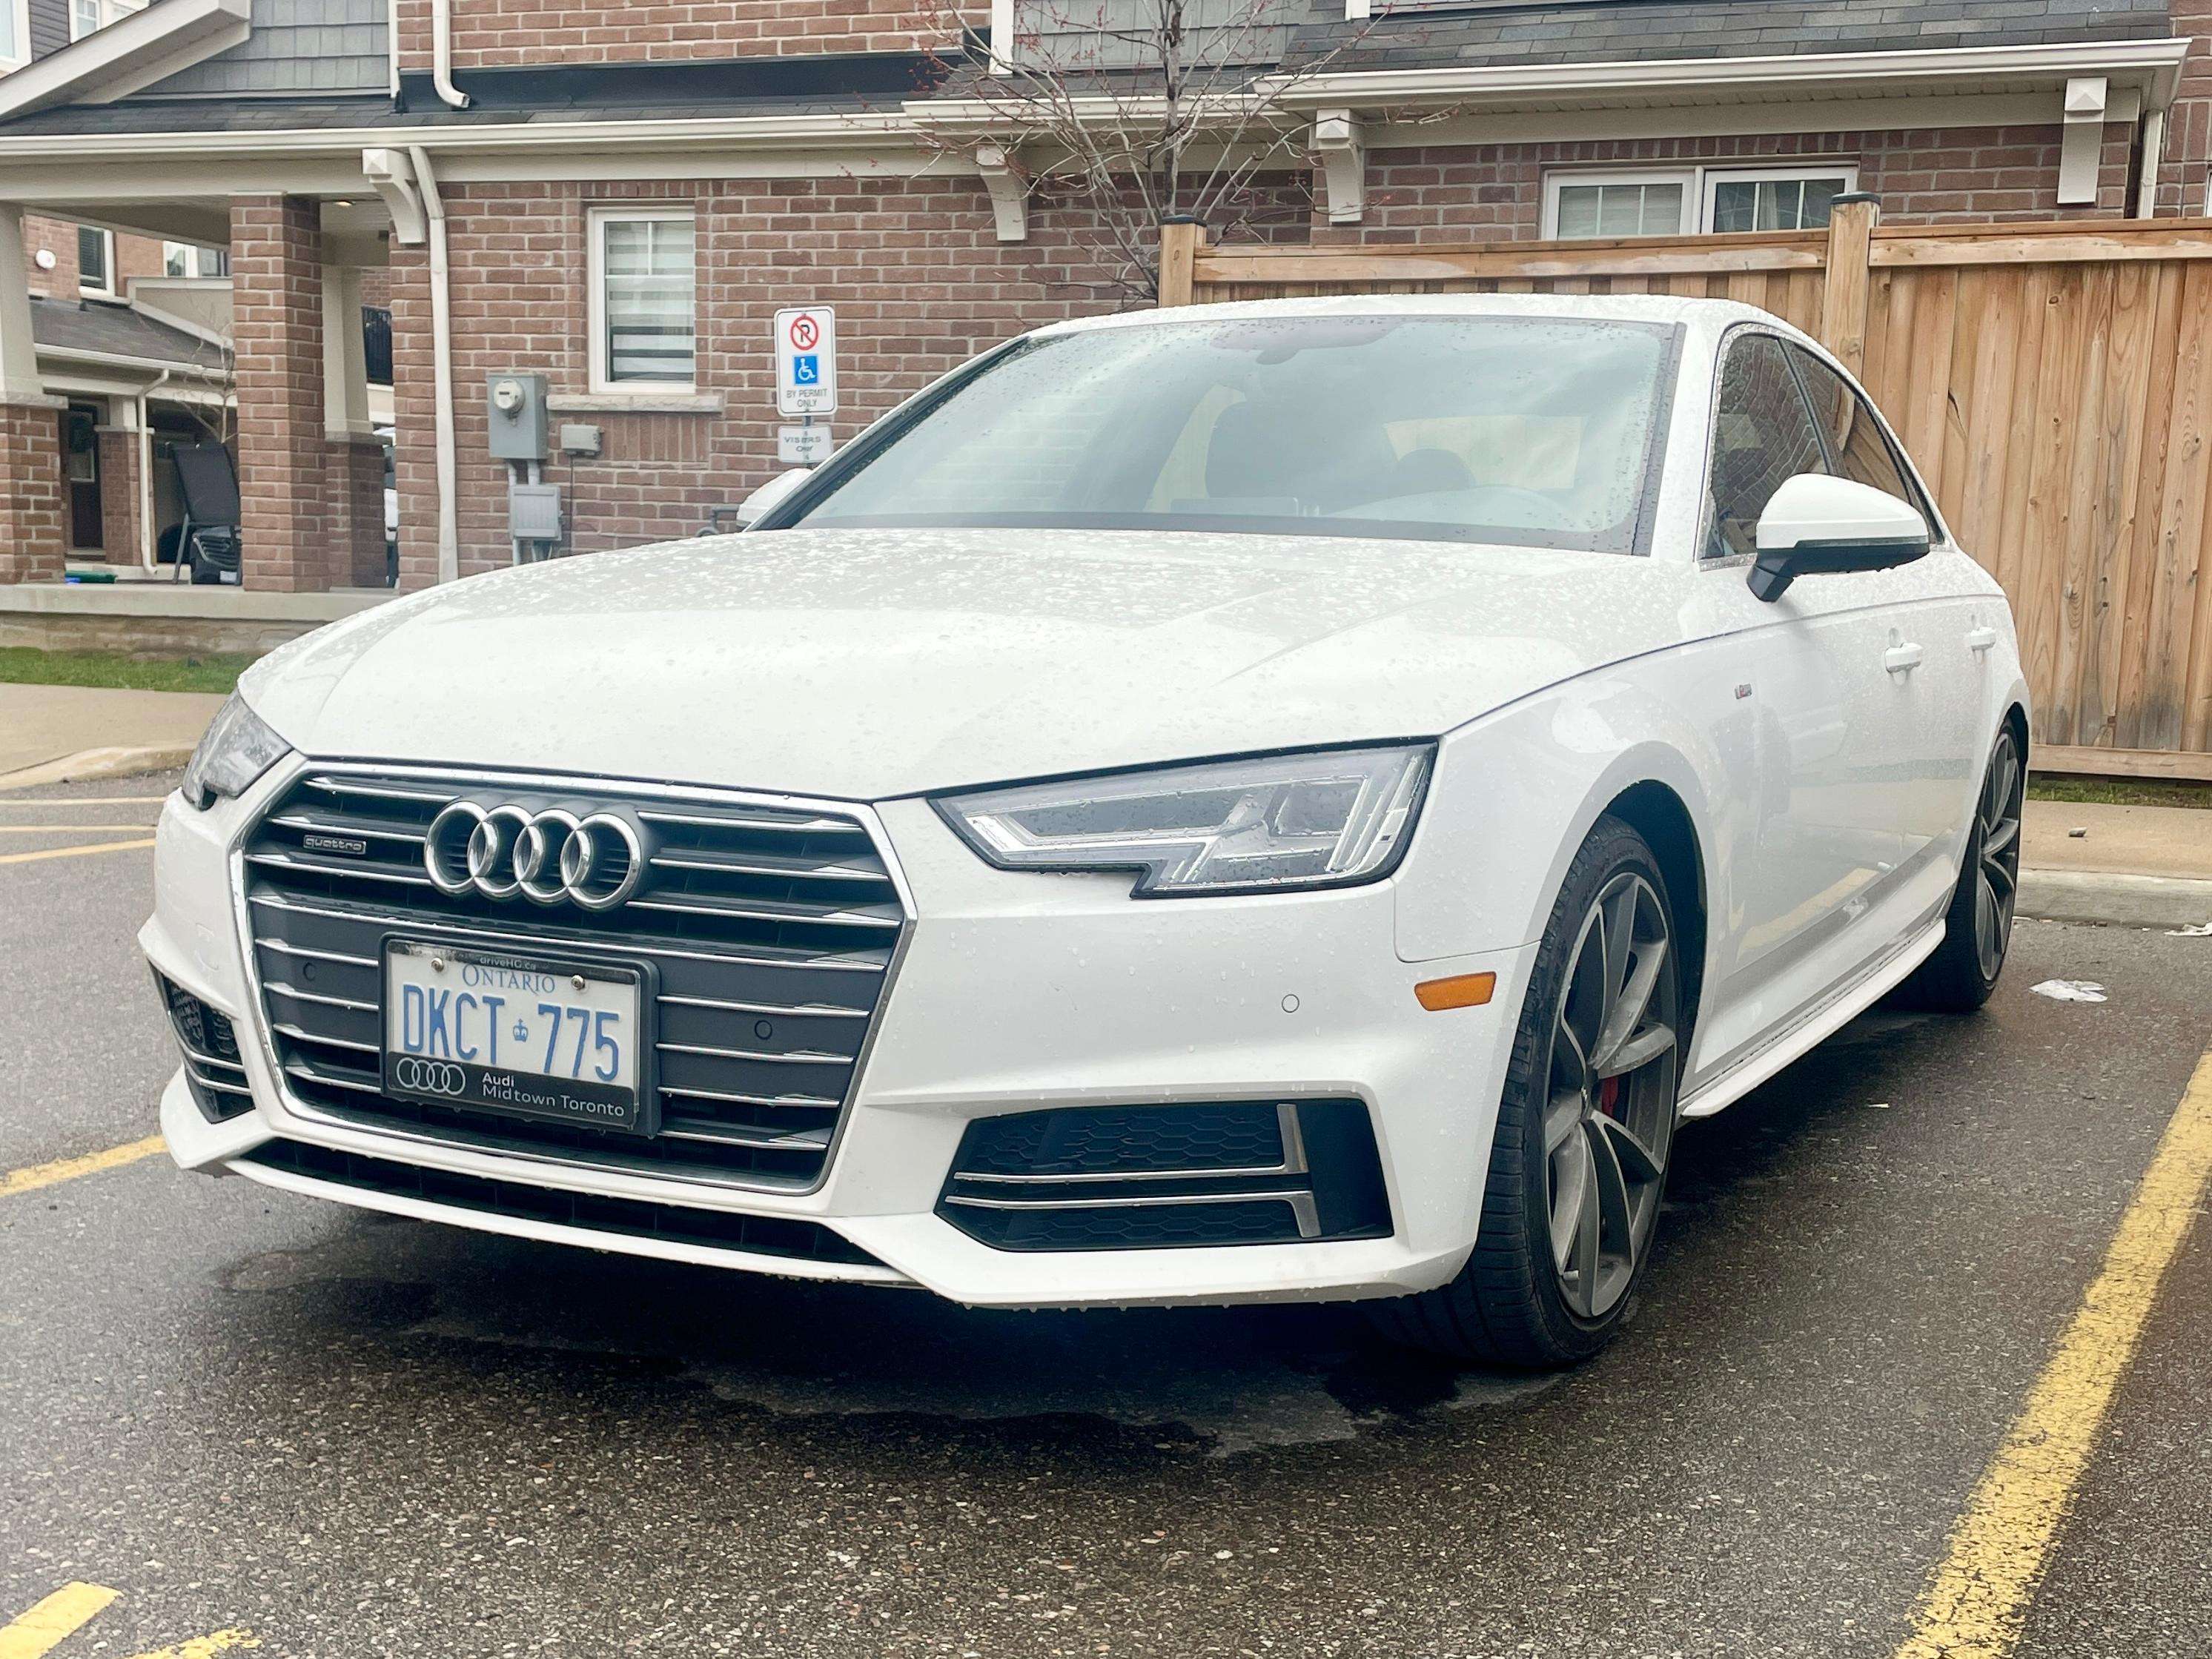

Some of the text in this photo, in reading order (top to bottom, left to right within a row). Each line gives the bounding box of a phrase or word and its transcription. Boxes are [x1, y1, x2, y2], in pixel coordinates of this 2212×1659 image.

[786, 388, 828, 398] BY PERMIT
[796, 399, 817, 408] ONLY
[305, 837, 362, 852] quattro
[403, 984, 620, 1082] DKCT 775
[482, 1072, 514, 1087] Audi
[482, 1085, 625, 1117] Midtown Toronto
